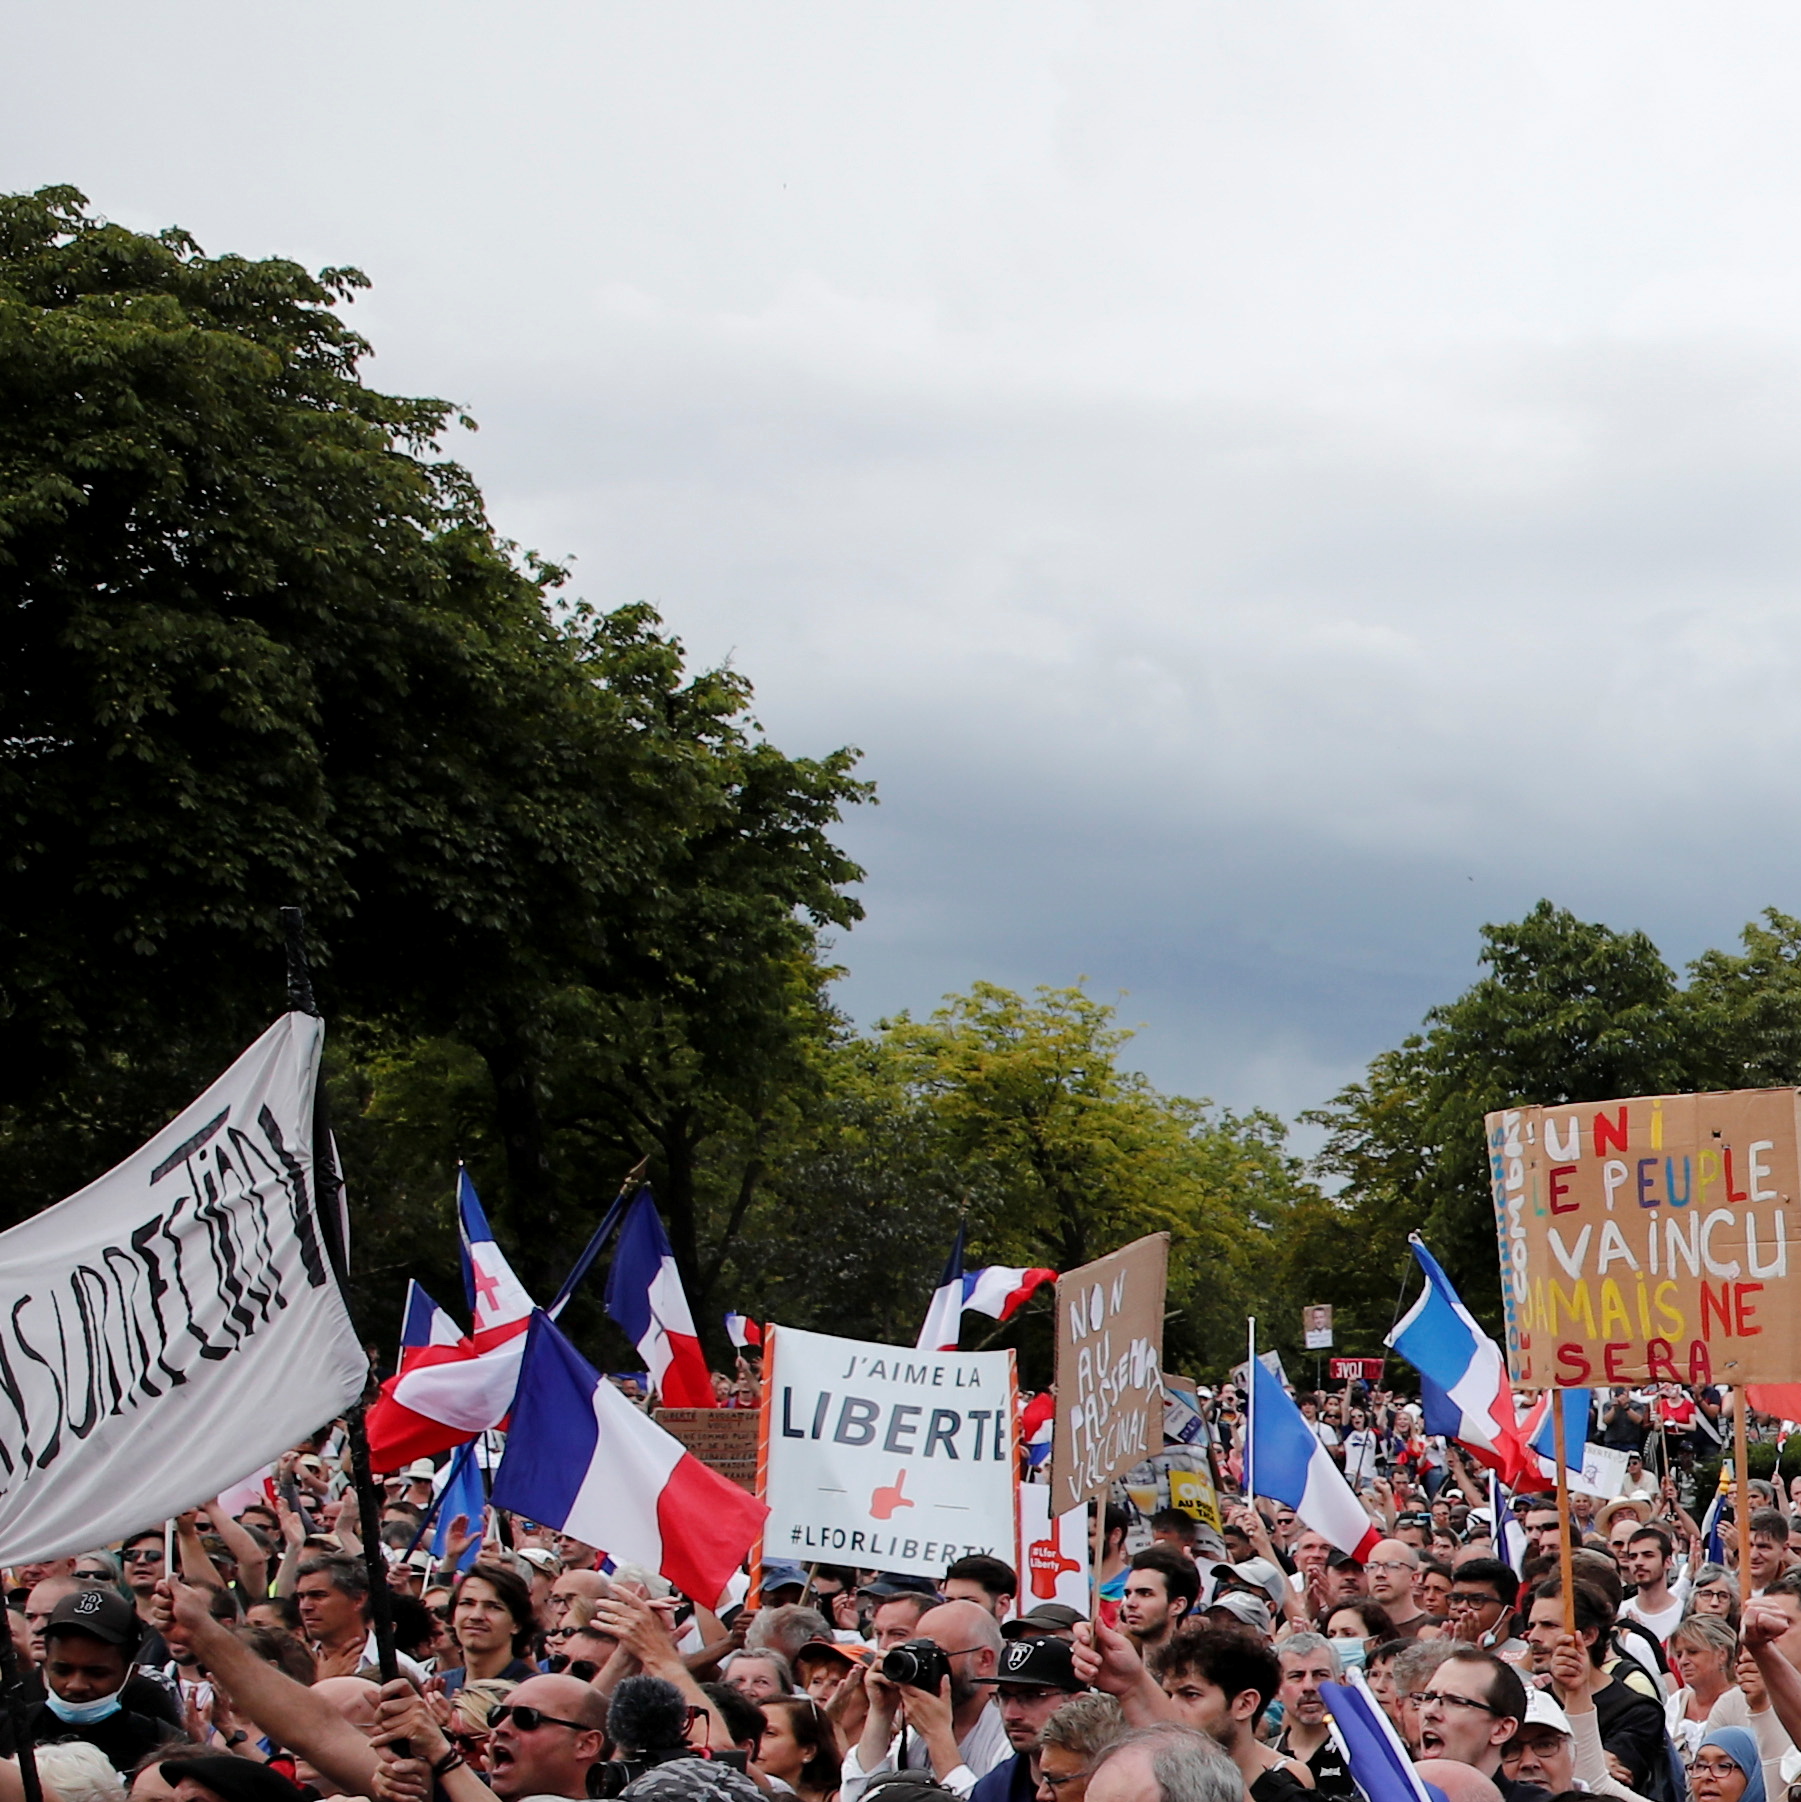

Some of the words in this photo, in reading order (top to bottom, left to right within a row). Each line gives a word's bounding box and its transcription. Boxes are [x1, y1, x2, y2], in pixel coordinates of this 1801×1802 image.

[1532, 1165, 1580, 1216] LE
[1603, 1140, 1777, 1211] PEUPLE
[1069, 1270, 1127, 1344] NON
[1700, 1280, 1764, 1341] NE
[842, 1355, 944, 1387] J'AIME
[955, 1367, 981, 1388] LA
[1077, 1331, 1110, 1404] AU
[1554, 1337, 1712, 1386] SERA
